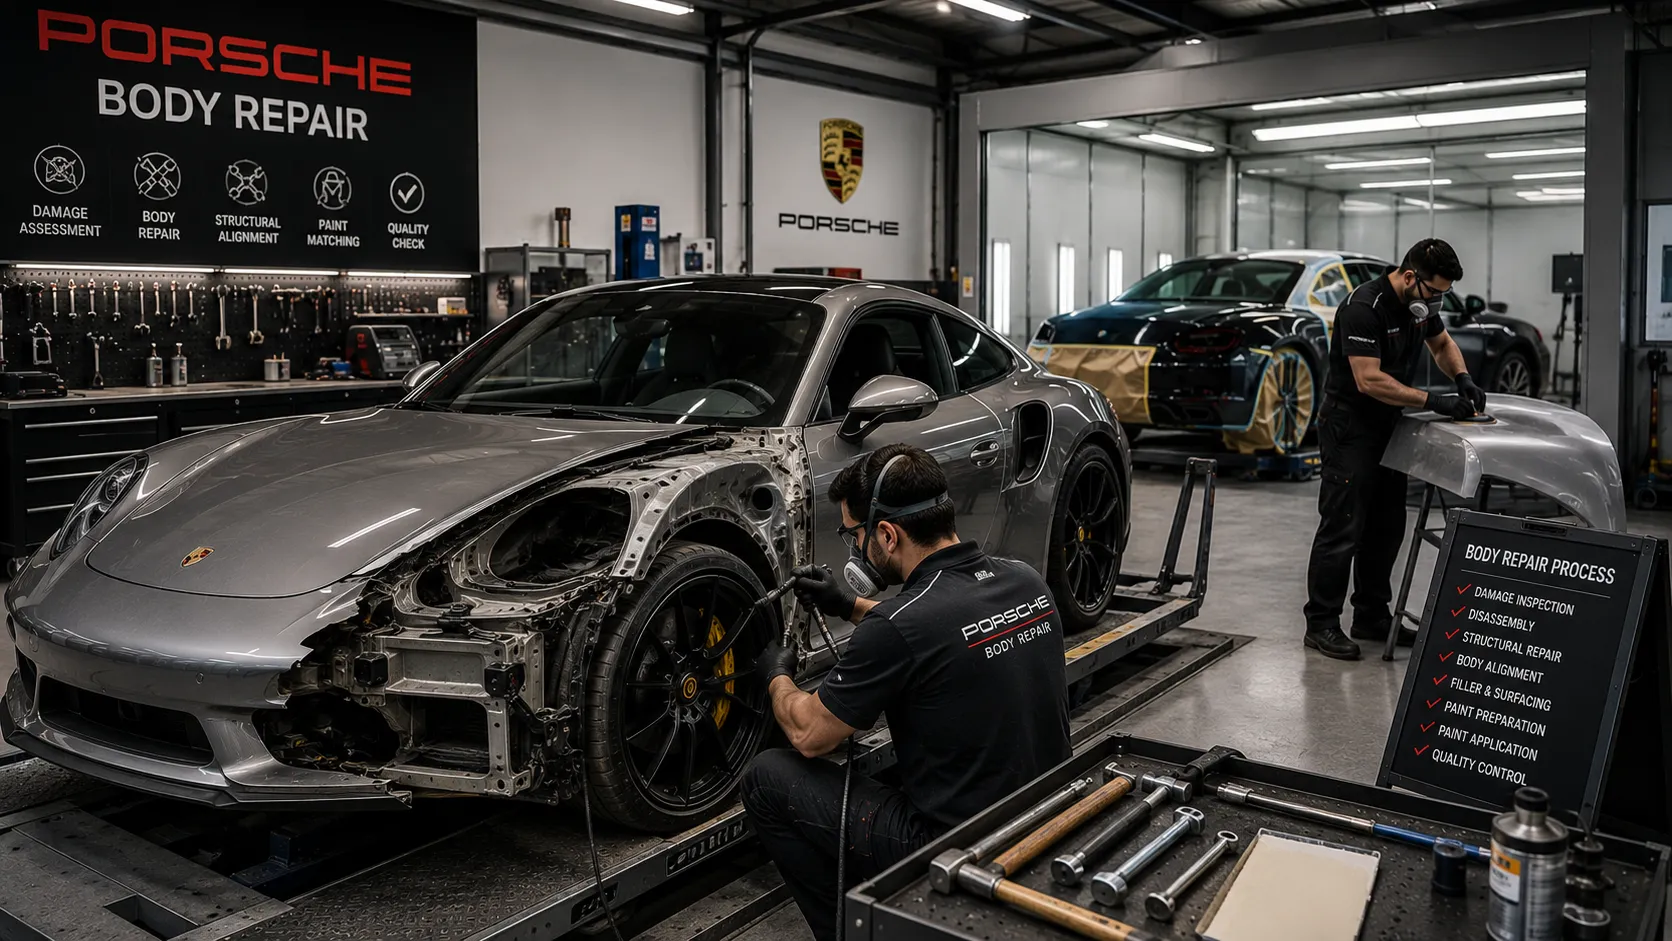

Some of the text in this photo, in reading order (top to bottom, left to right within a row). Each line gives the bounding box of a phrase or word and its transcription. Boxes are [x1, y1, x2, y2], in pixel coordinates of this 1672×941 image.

[38, 9, 412, 96] PORSCHE
[98, 79, 368, 141] BODY REPAIR
[33, 205, 88, 220] DAMAGE
[142, 210, 175, 224] BODY
[215, 214, 281, 229] STRUCTURAL
[318, 219, 348, 232] PAINT
[779, 213, 899, 236] PORSCHE
[19, 222, 102, 238] ASSESSMENT
[139, 227, 180, 240] REPAIR
[218, 231, 279, 244] ALIGNMENT
[307, 234, 360, 248] MATCHING
[388, 222, 429, 237] QUALITY
[393, 238, 425, 249] CHECK
[1465, 544, 1615, 584] BODY REPAIR PROCESS
[1475, 586, 1575, 616] DAMAGE INSPECTION
[961, 595, 1049, 641] PORSCHE
[1468, 609, 1536, 632] DISASSEMBLY
[985, 621, 1052, 659] BODY REPAIR
[1463, 632, 1562, 663] STRUCTURAL REPAIR
[1457, 654, 1544, 684] BODY ALIGNMENT
[1451, 678, 1552, 711] FILLER & SURFACING
[1444, 701, 1546, 736] PAINT PREPARATION
[1438, 725, 1538, 761] PAINT APPLICATION
[1432, 749, 1527, 786] QUALITY CONTROL
